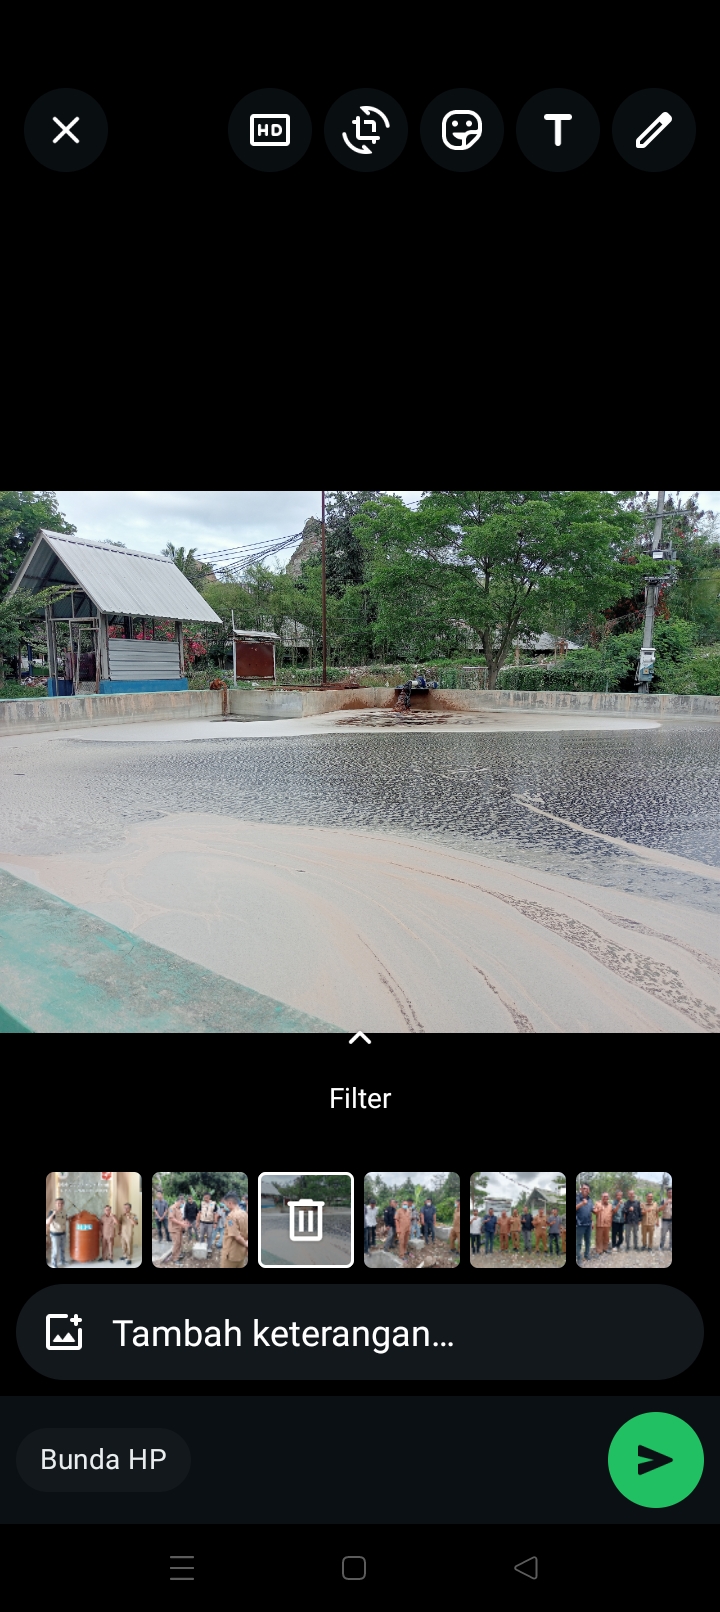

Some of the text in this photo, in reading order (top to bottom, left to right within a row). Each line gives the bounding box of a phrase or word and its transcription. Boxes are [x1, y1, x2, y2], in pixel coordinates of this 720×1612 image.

[257, 123, 283, 137] HD
[543, 113, 573, 147] T
[330, 1087, 392, 1109] Filter
[112, 1318, 454, 1355] Tambah keterangan...
[41, 1447, 167, 1470] Bunda HP
